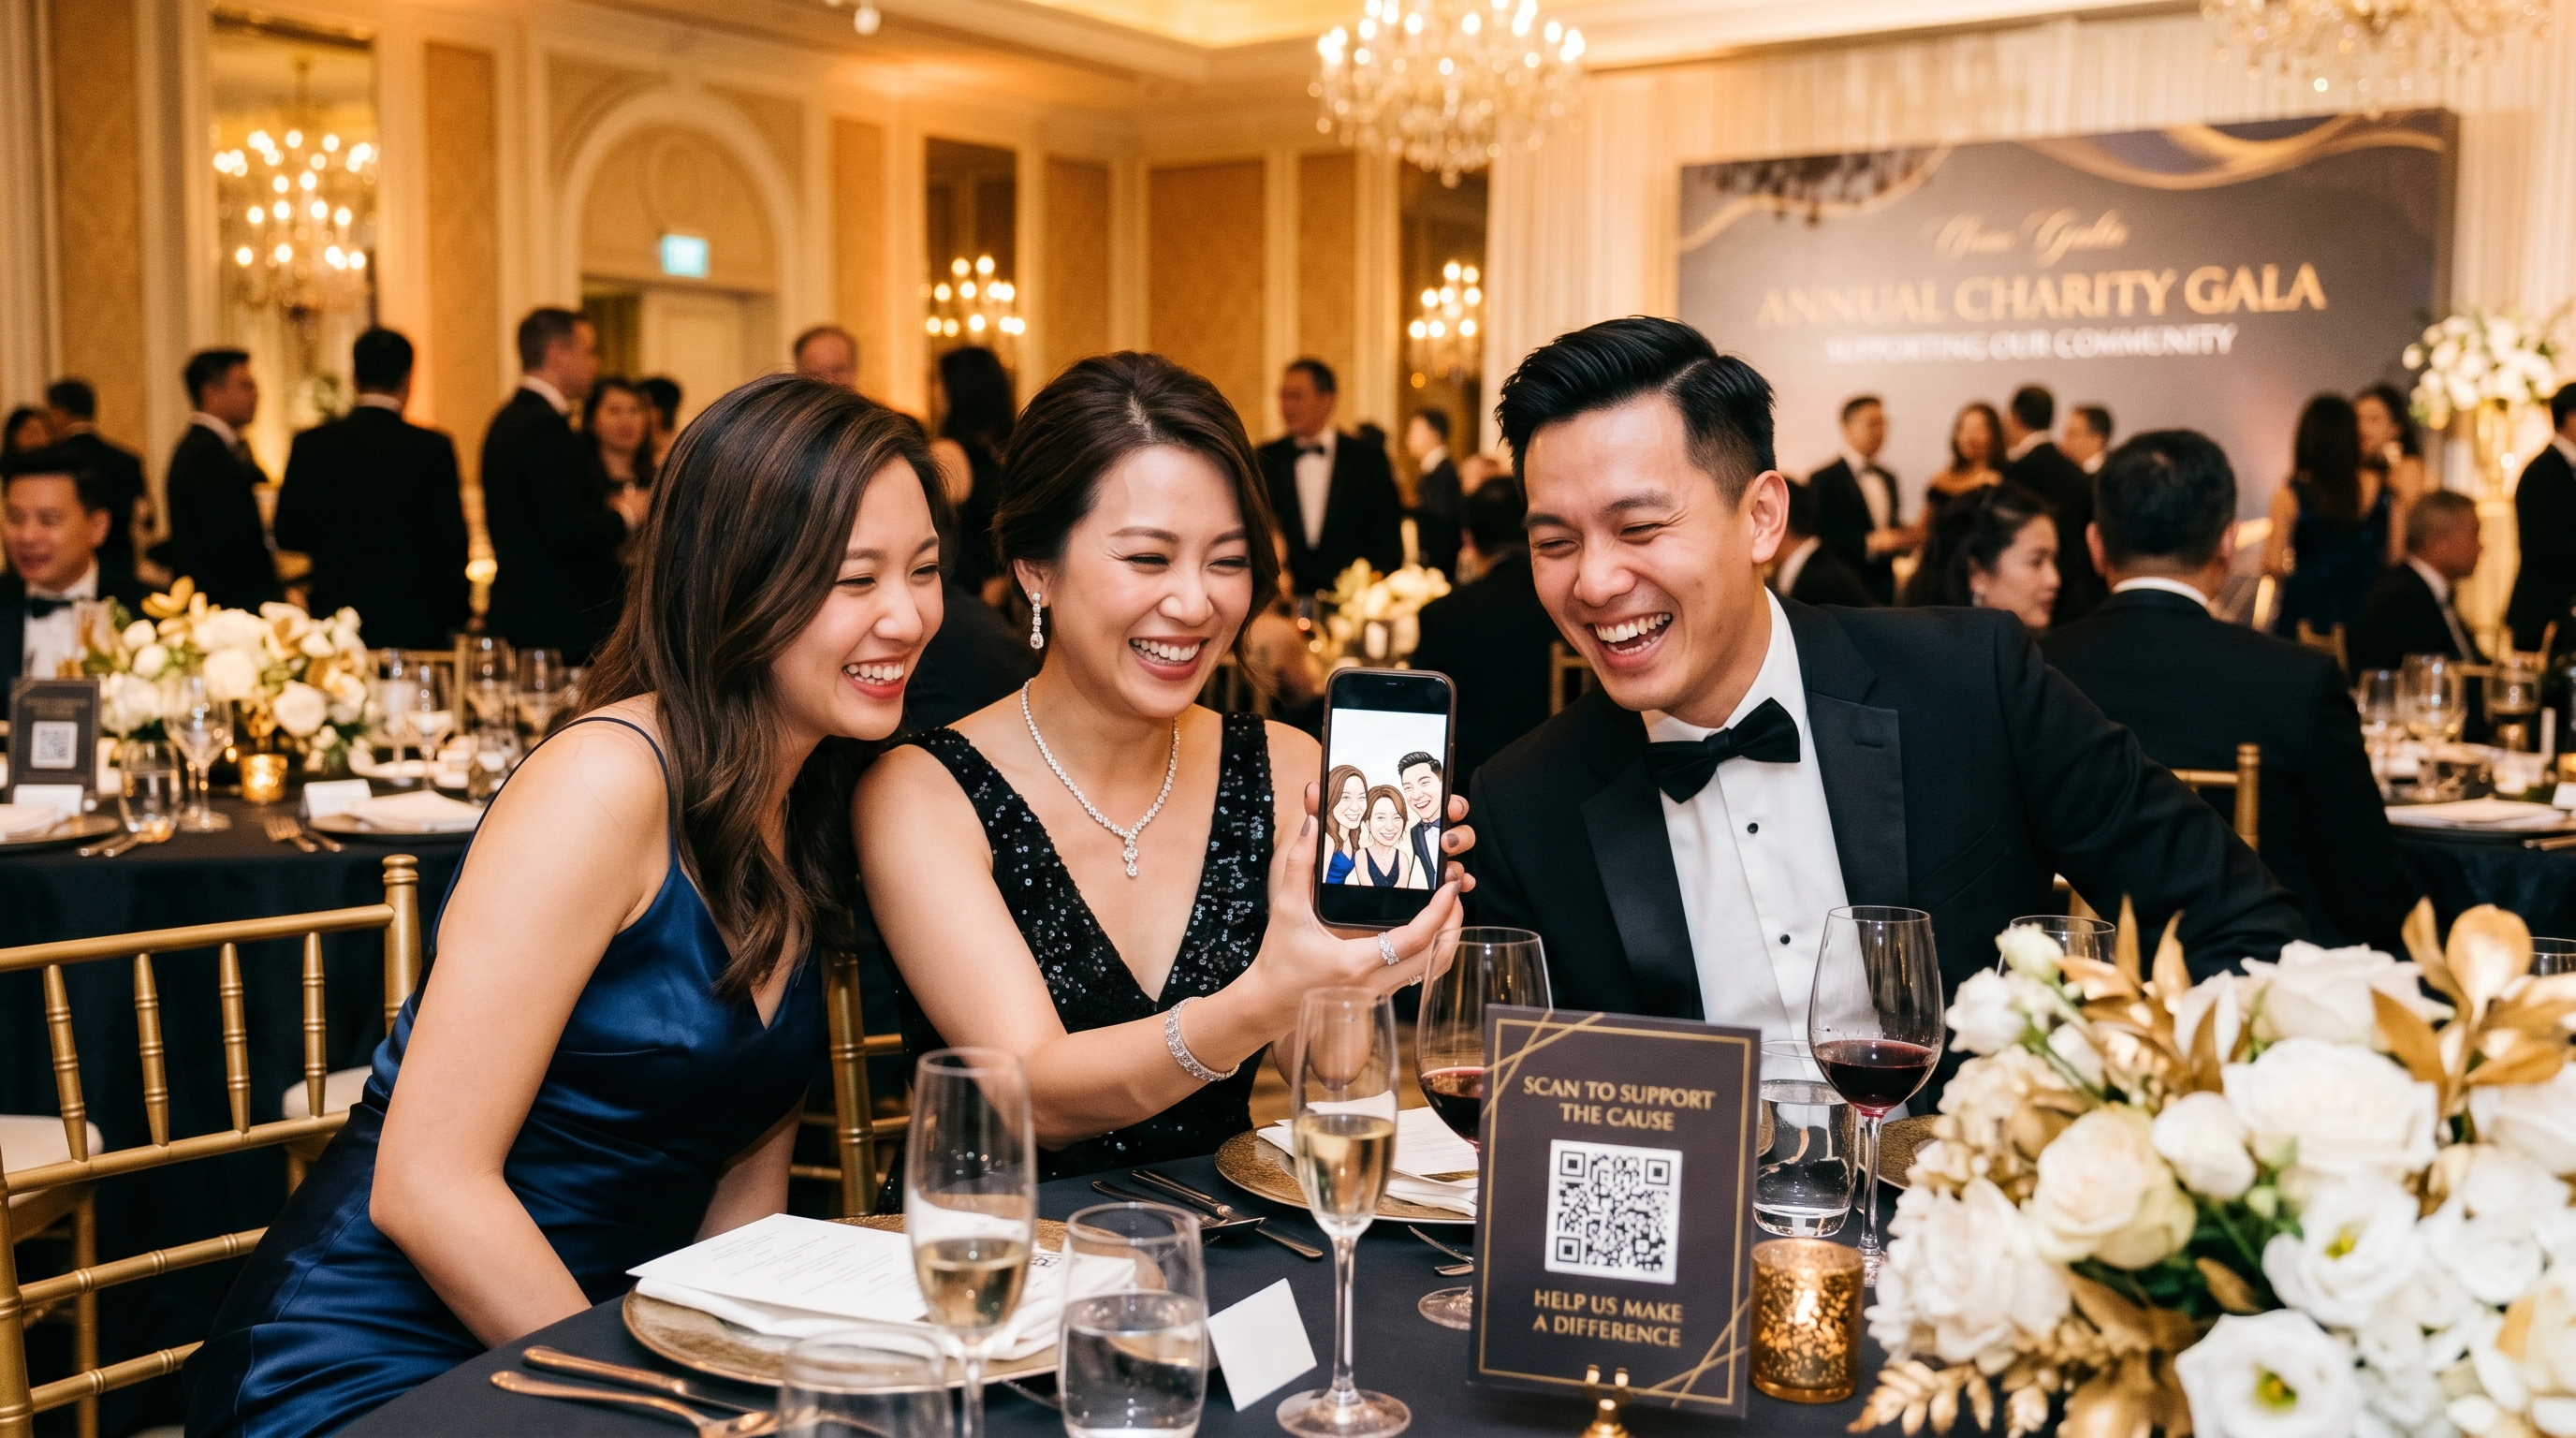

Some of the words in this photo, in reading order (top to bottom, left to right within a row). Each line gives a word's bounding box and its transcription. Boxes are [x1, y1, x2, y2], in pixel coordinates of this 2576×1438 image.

[1756, 279, 1947, 330] ANNUAL
[1954, 269, 2177, 322] CHARITY
[2184, 263, 2327, 314] GALA
[1989, 329, 2052, 360] OUR
[2054, 323, 2237, 360] COMMUNITY
[1523, 1076, 1580, 1099] SCAN
[1585, 1081, 1617, 1101] TO
[1619, 1084, 1717, 1109] SUPPORT
[1559, 1103, 1603, 1124] THE
[1606, 1107, 1675, 1131] CAUSE
[1534, 1289, 1587, 1311] HELP
[1591, 1296, 1618, 1315] US
[1623, 1299, 1683, 1323] MAKE
[1532, 1314, 1548, 1331] A
[1554, 1315, 1681, 1347] DIFFERENCE
